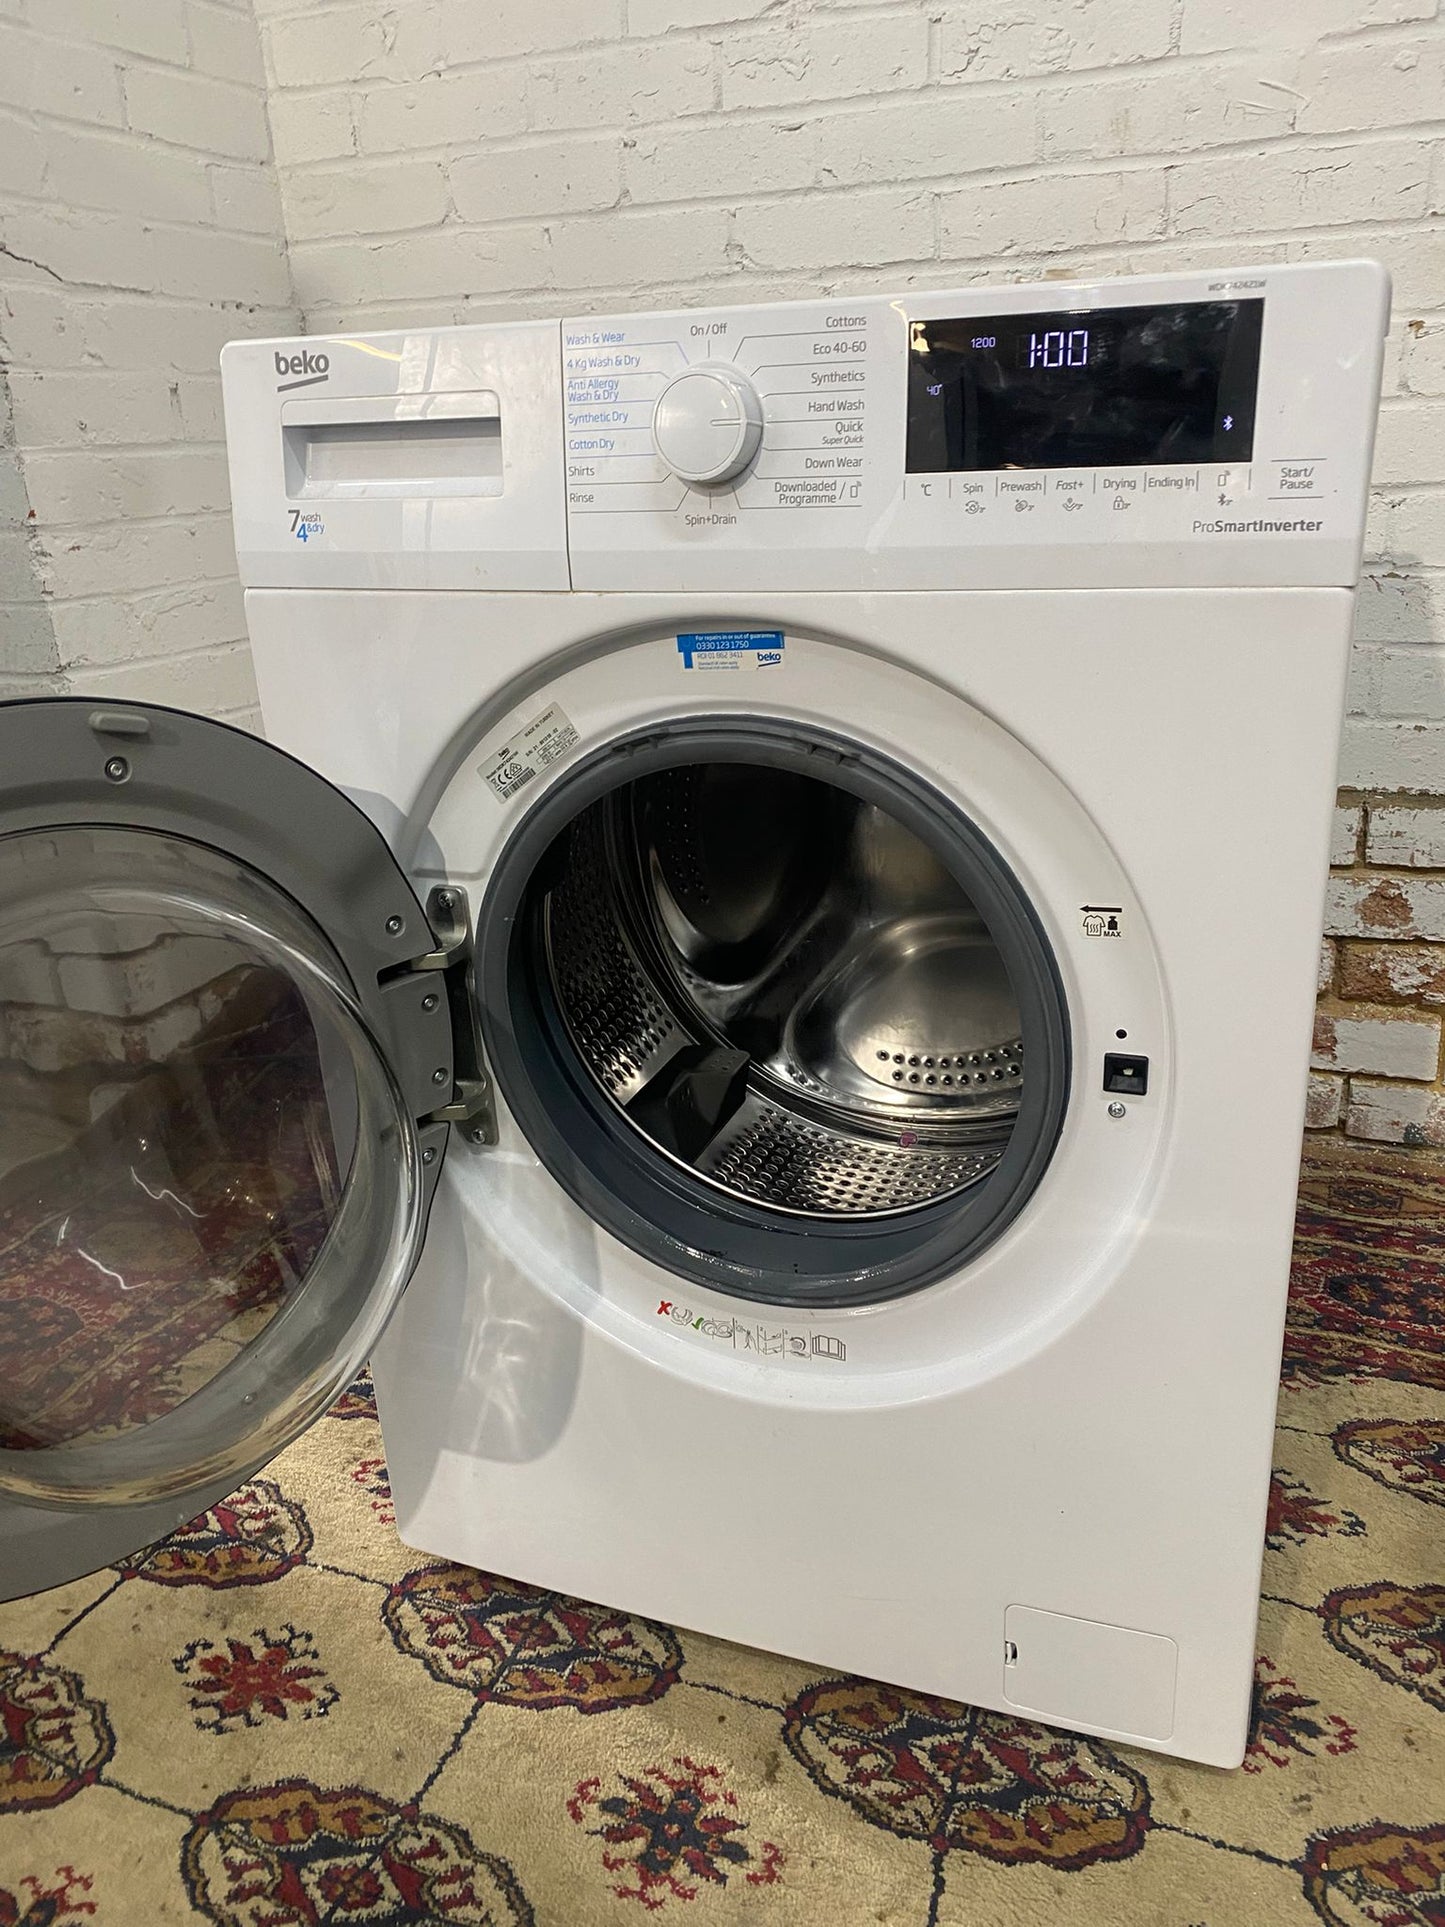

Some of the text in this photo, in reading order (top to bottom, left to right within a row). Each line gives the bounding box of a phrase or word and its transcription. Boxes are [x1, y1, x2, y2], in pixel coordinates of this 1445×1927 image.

[826, 316, 867, 328] Cottons
[566, 332, 625, 345] Wash & Wear
[970, 337, 996, 349] 1200
[813, 340, 867, 355] Eco 40-60
[1029, 330, 1088, 368] 1:00
[274, 350, 330, 376] beko
[567, 354, 641, 371] 4 Kg Wash & Dry
[568, 378, 619, 391] Anti Allergy
[811, 370, 866, 386] Synthetics
[568, 389, 619, 402] Wash & Dry
[808, 399, 865, 412] Hand Wash
[568, 411, 628, 426] Synthetic Dry
[835, 421, 864, 434] Quick
[569, 438, 615, 451] Cotton Dry
[822, 434, 864, 445] Super Quick
[805, 457, 863, 469] Down Wear
[568, 466, 595, 477] Shirts
[1280, 467, 1314, 478] Start/
[775, 481, 837, 493] Downloaded
[1000, 480, 1042, 492] Prewash
[1056, 480, 1084, 490] Fast+
[1103, 478, 1137, 491] Drying
[1148, 475, 1195, 489] Ending In
[1280, 478, 1314, 490] Pause
[963, 483, 984, 495] Spin
[570, 493, 594, 503] Rinse
[779, 494, 837, 507] Programme
[288, 509, 321, 532] 7 wash
[685, 514, 736, 527] Spin+Drain
[1193, 520, 1323, 533] ProSmartInverter
[296, 523, 308, 542] 4
[696, 640, 749, 650] 0330 123 1750
[757, 652, 782, 662] beko
[1103, 930, 1122, 938] MAX
